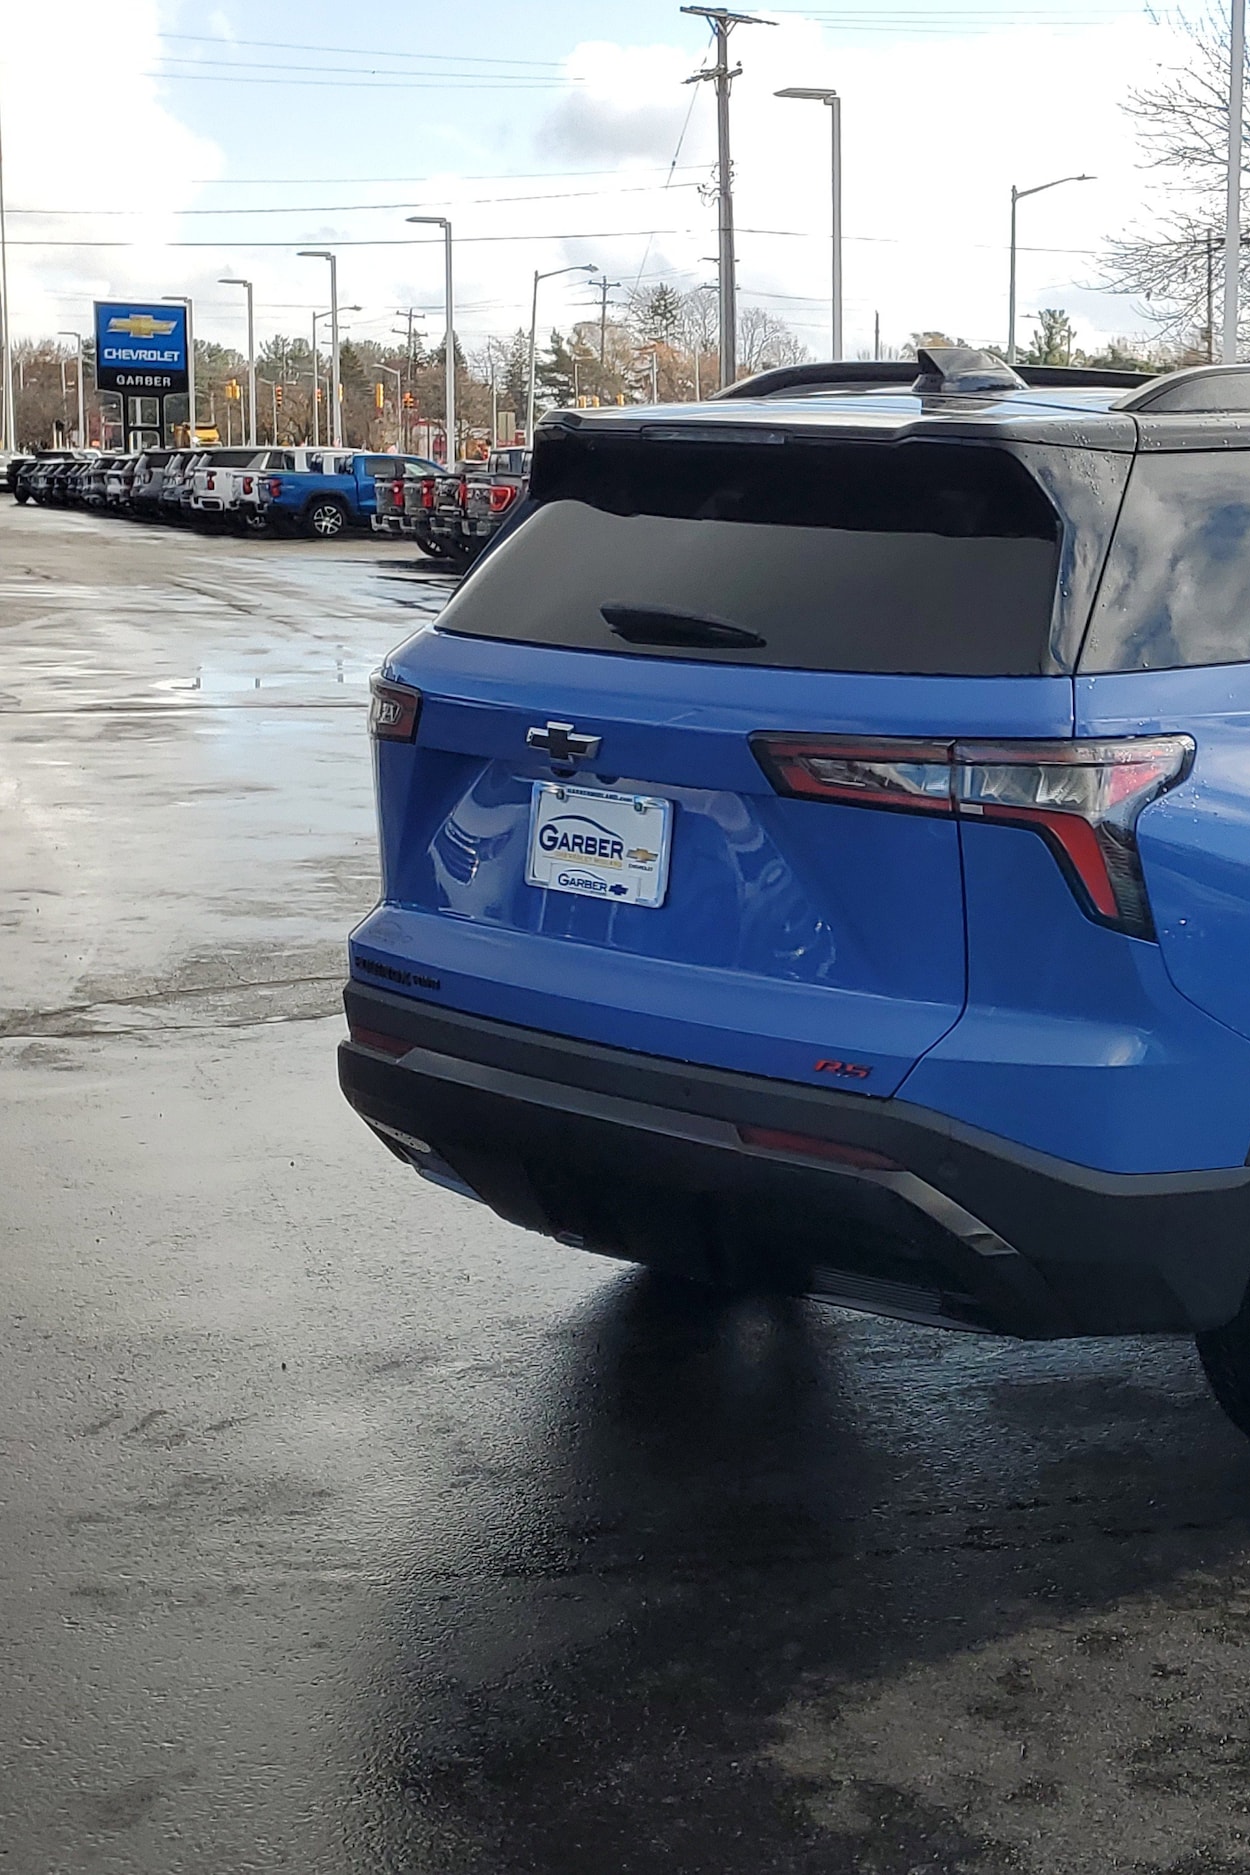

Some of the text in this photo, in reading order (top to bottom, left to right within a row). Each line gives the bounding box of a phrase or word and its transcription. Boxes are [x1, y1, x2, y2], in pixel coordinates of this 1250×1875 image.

[104, 347, 180, 362] CHEVROLET
[116, 374, 171, 387] GARBER
[538, 823, 624, 860] GARBER
[558, 873, 608, 892] GARBER
[813, 1060, 872, 1079] RS
